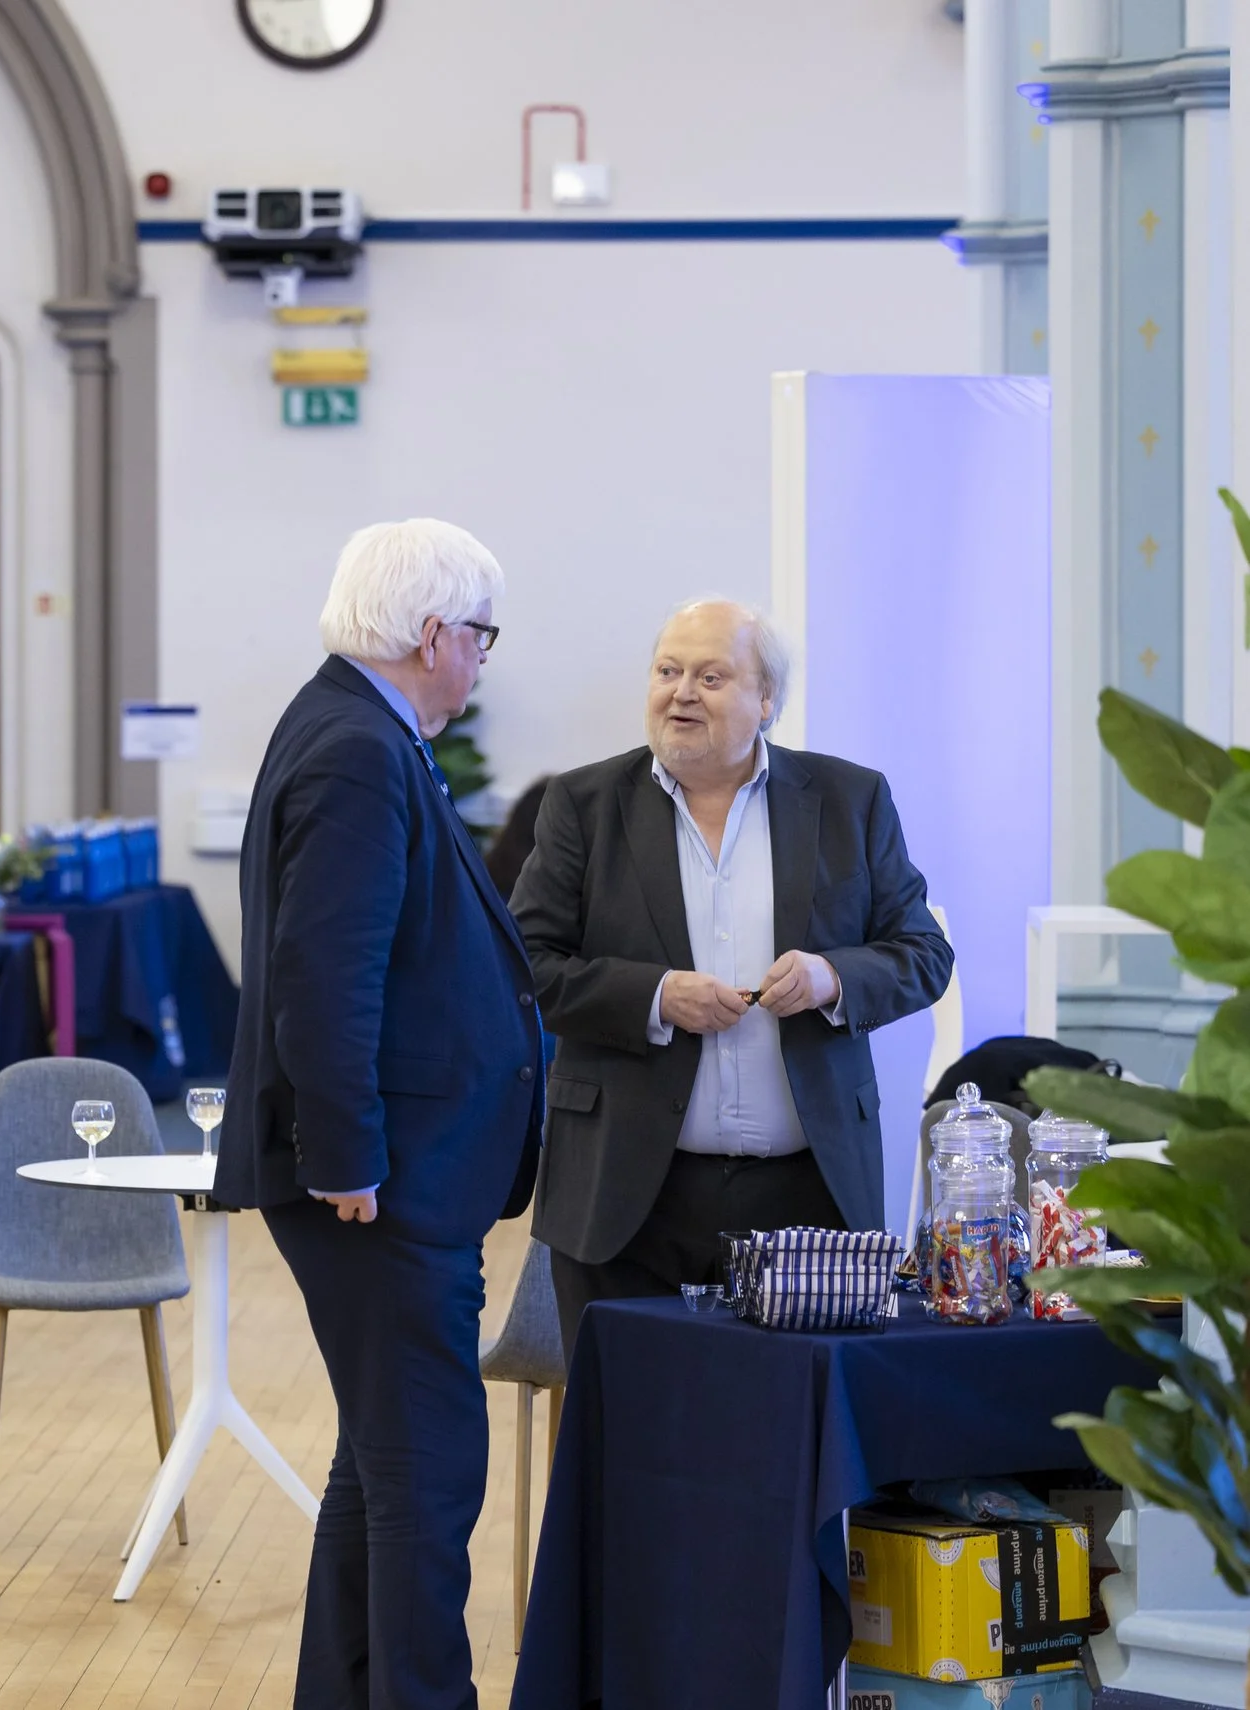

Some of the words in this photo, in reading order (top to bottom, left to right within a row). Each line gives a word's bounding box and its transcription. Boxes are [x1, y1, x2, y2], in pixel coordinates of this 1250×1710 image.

[1011, 1541, 1022, 1575] prime
[1034, 1547, 1046, 1586] amazon
[1013, 1581, 1023, 1619] amazon
[1036, 1586, 1049, 1621] prime
[1021, 1639, 1048, 1653] prime
[1050, 1634, 1083, 1648] amazon
[848, 1694, 893, 1710] OPER
